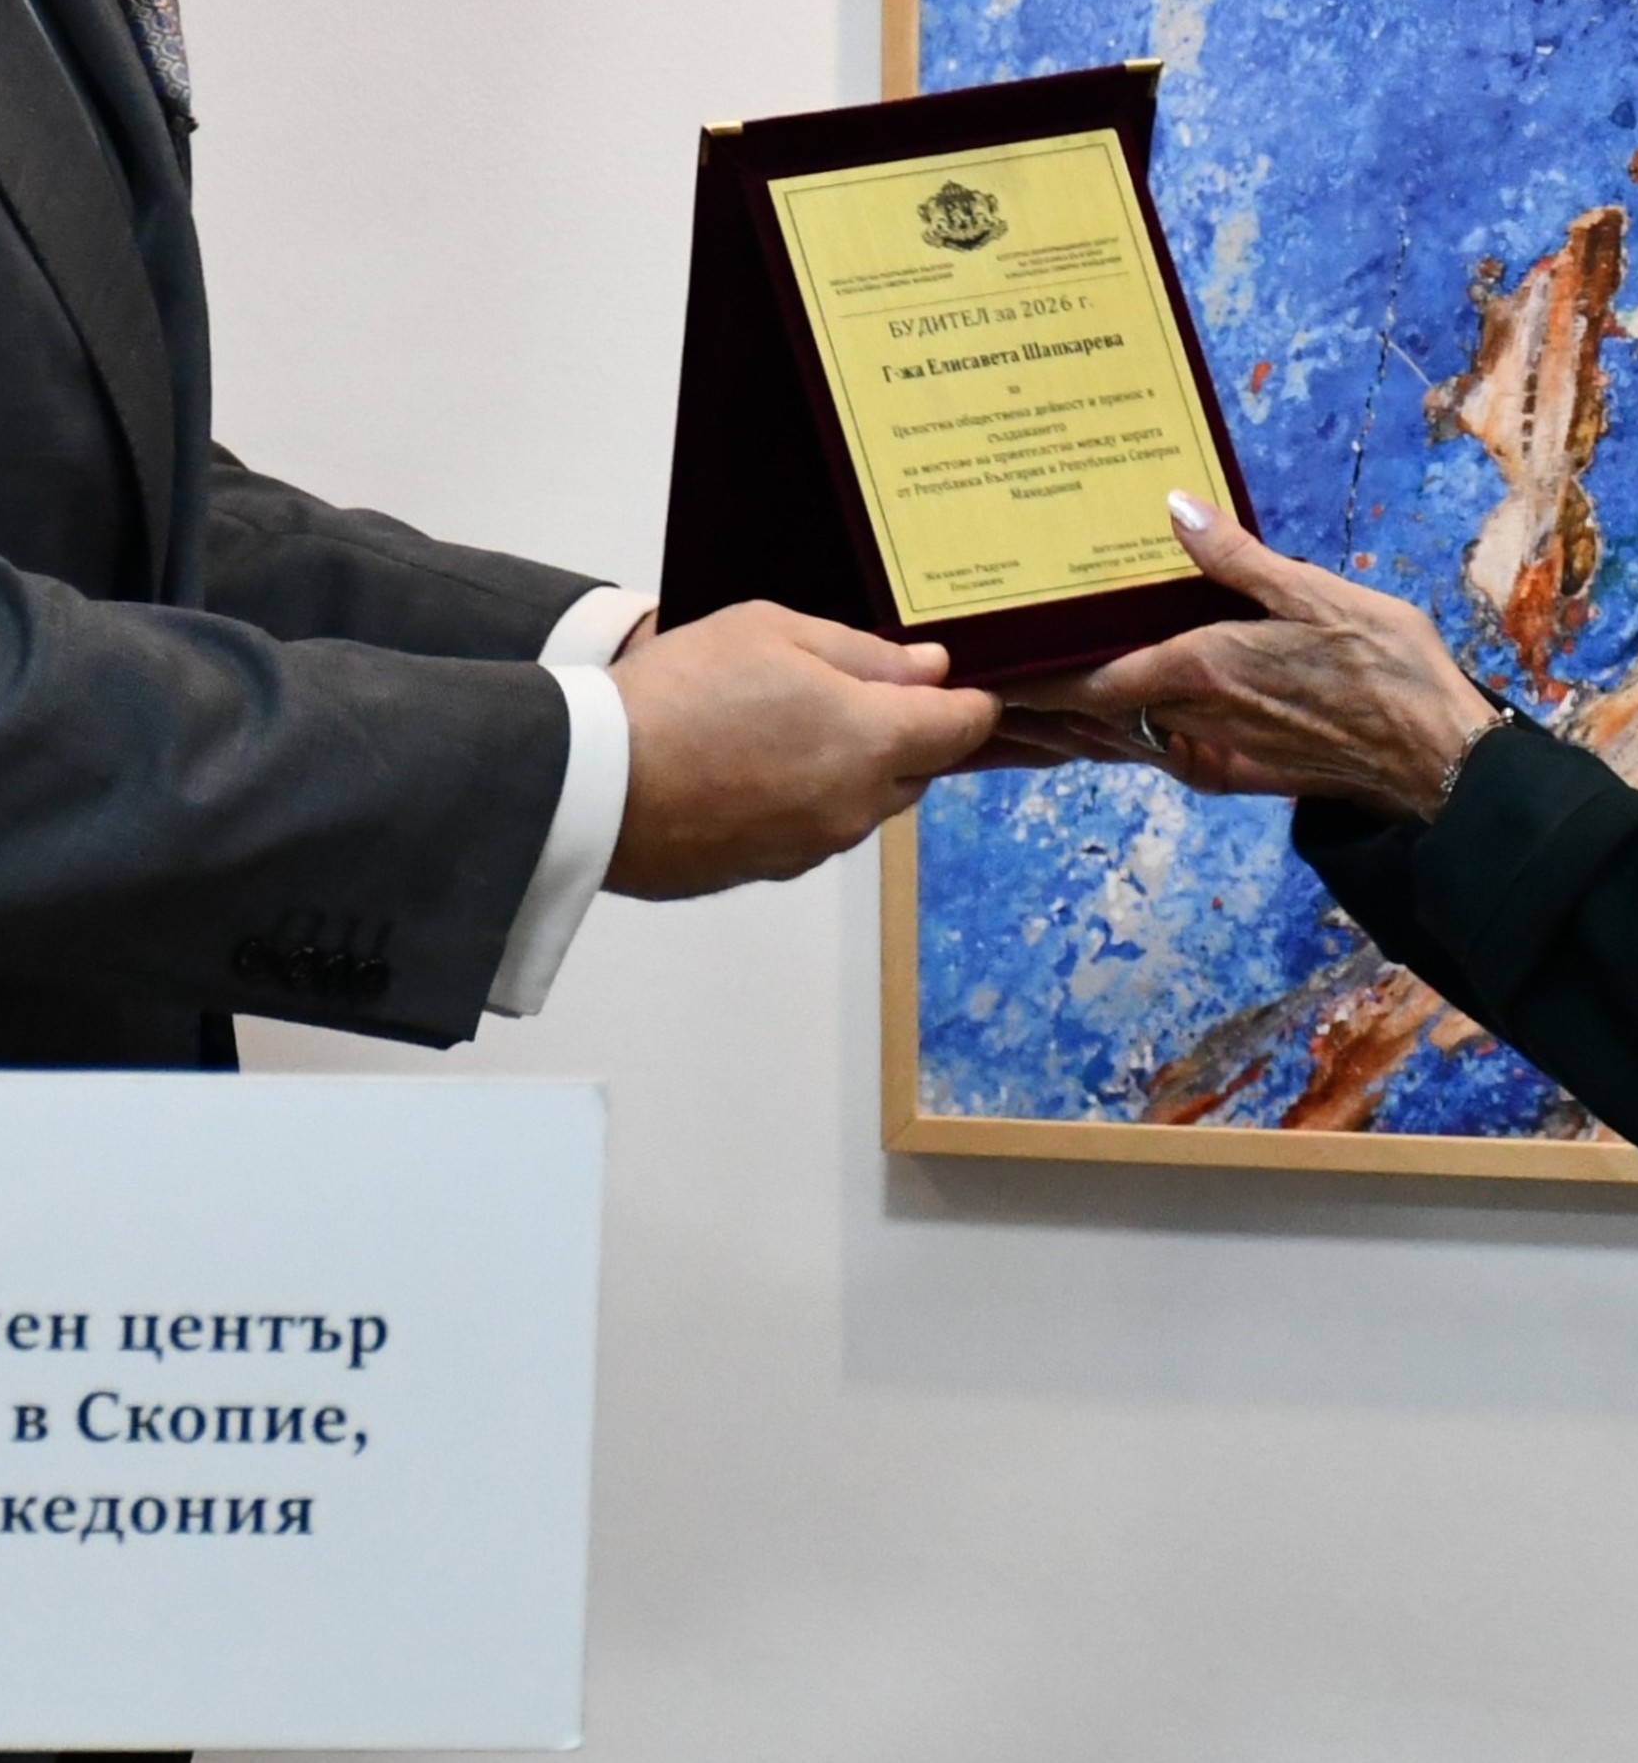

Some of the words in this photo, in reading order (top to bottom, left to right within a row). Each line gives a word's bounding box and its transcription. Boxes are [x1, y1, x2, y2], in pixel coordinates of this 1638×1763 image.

[888, 307, 990, 338] БУДИТЕЛ
[995, 307, 1016, 323] за
[1020, 295, 1072, 319] 2026
[882, 363, 924, 383] Г-жа
[926, 348, 1020, 376] Елисавета
[1021, 333, 1124, 362] Шапкарева
[913, 477, 982, 496] Република
[983, 466, 1045, 484] България
[1058, 453, 1127, 472] Република
[1128, 445, 1181, 461] Северна
[1010, 480, 1082, 499] Македония
[118, 1310, 390, 1370] център
[11, 1403, 50, 1443] в
[75, 1388, 370, 1455] Скопие,
